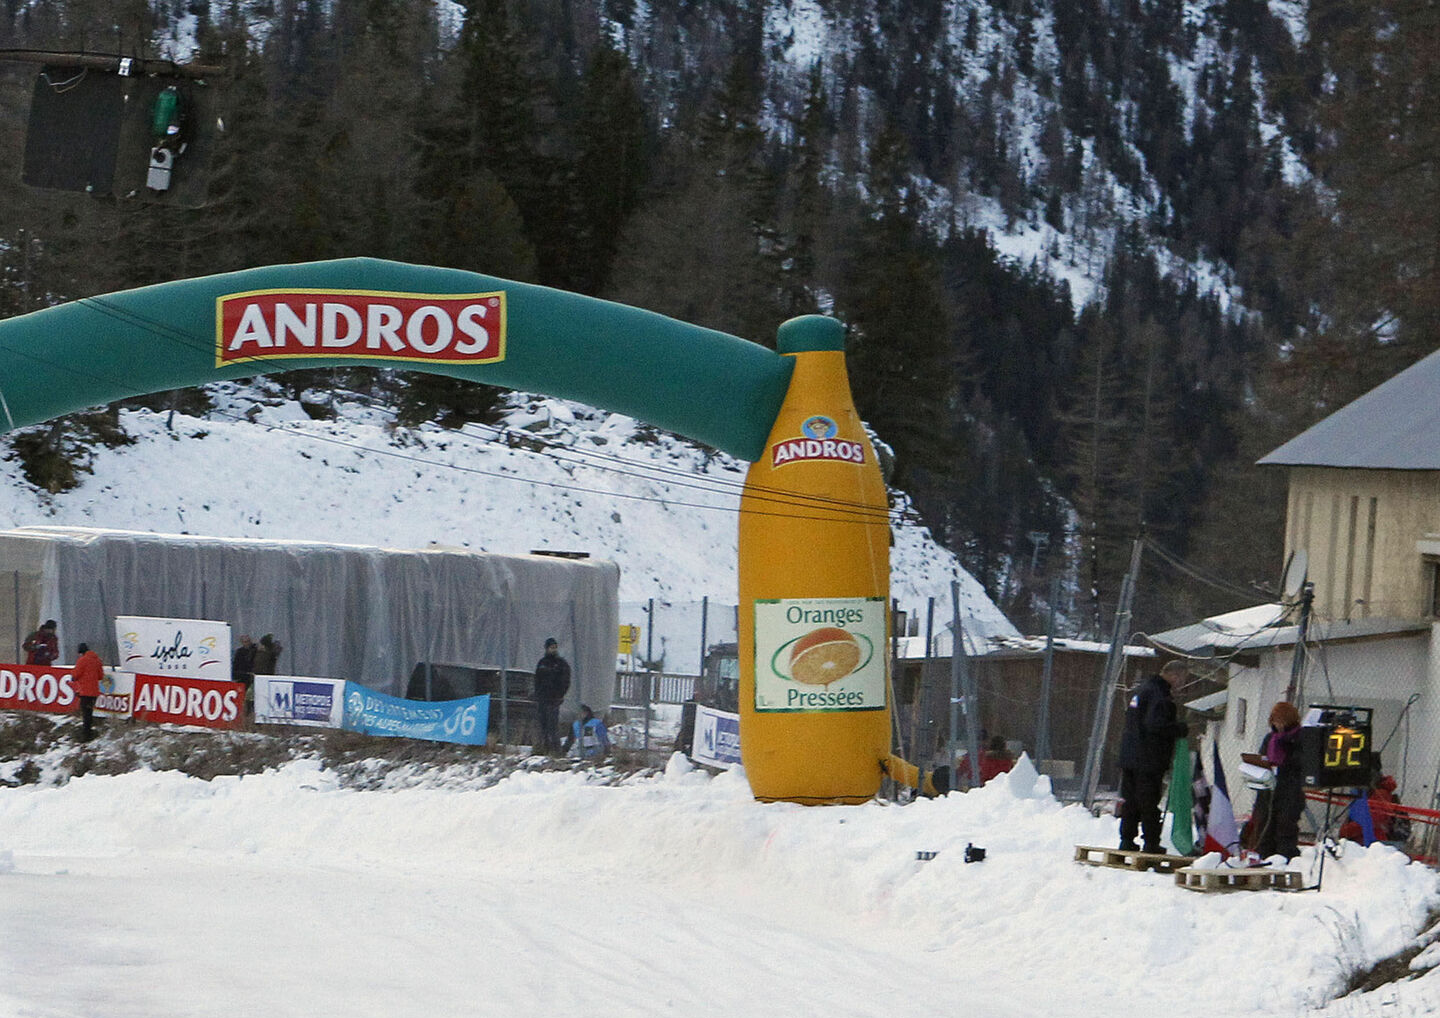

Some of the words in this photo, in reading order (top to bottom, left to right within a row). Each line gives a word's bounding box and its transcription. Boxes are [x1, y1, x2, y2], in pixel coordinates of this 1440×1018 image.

[228, 302, 489, 354] ANDROS
[774, 440, 864, 464] ANDROS
[787, 606, 864, 628] Oranges
[150, 630, 193, 662] isola
[135, 683, 239, 722] ANDROS
[788, 688, 864, 707] Pressées
